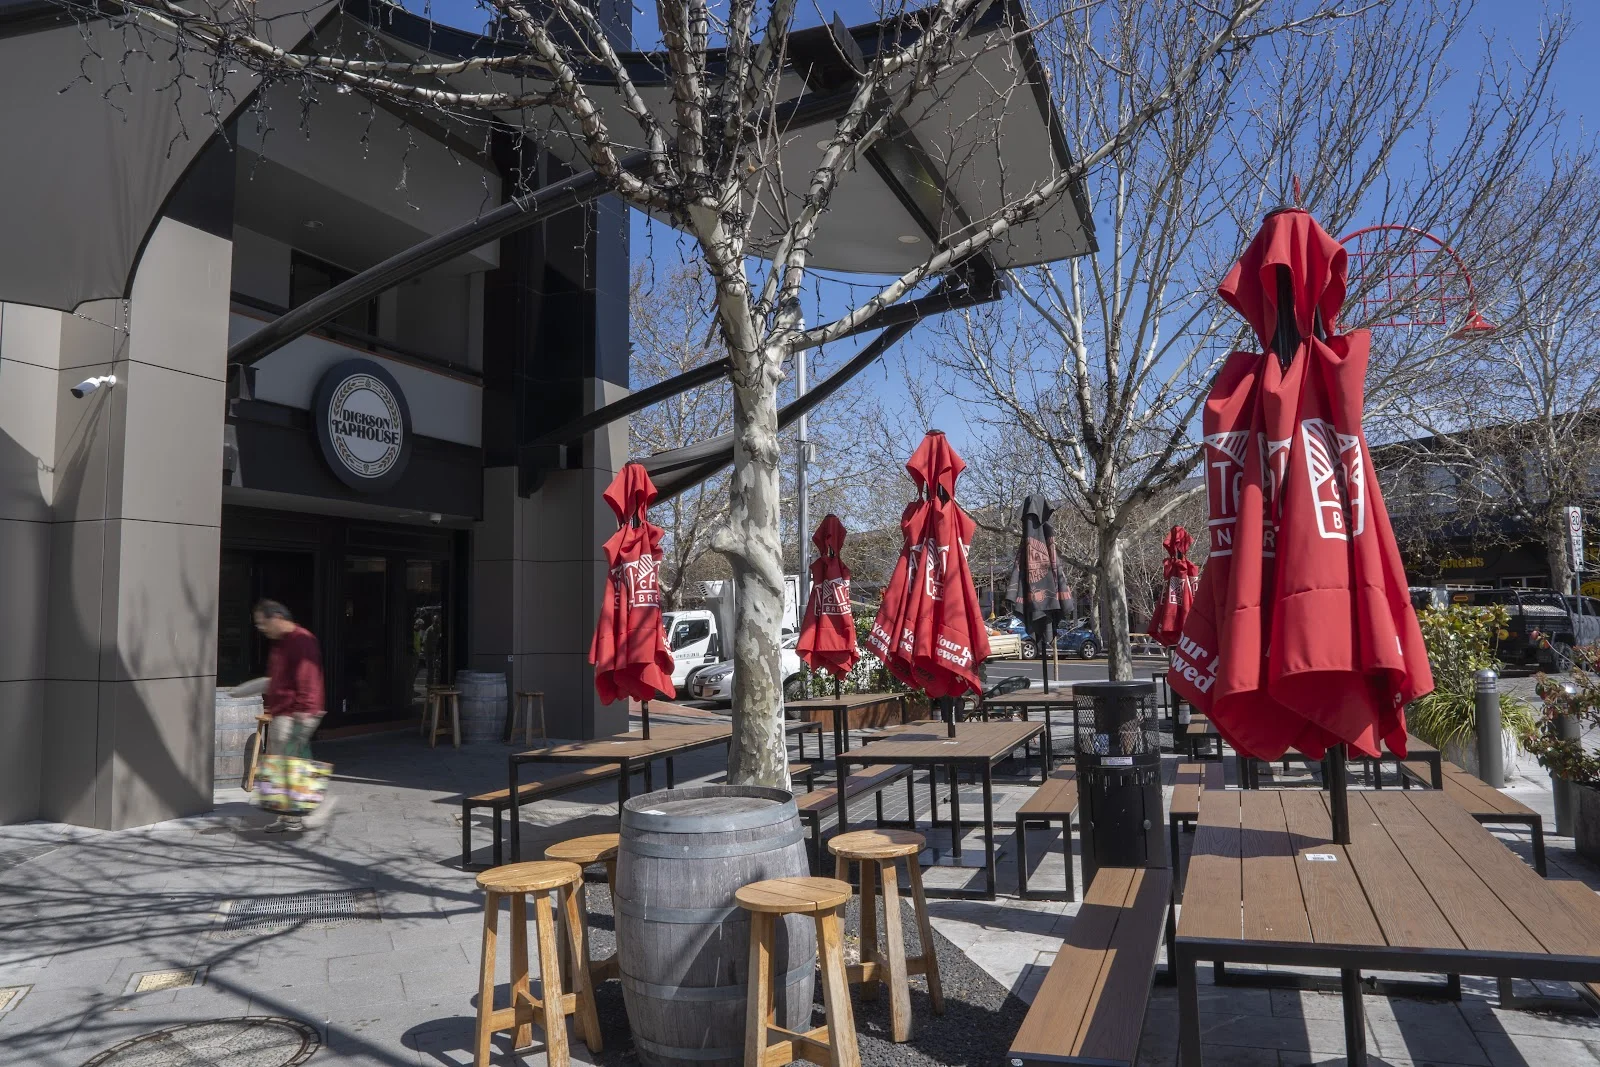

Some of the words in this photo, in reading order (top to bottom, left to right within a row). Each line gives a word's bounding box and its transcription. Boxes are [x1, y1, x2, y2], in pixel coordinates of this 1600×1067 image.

[342, 409, 393, 430] DICKSON
[332, 419, 400, 446] TAPHOUSE
[1571, 515, 1580, 526] 20
[1439, 556, 1485, 569] BURGERS
